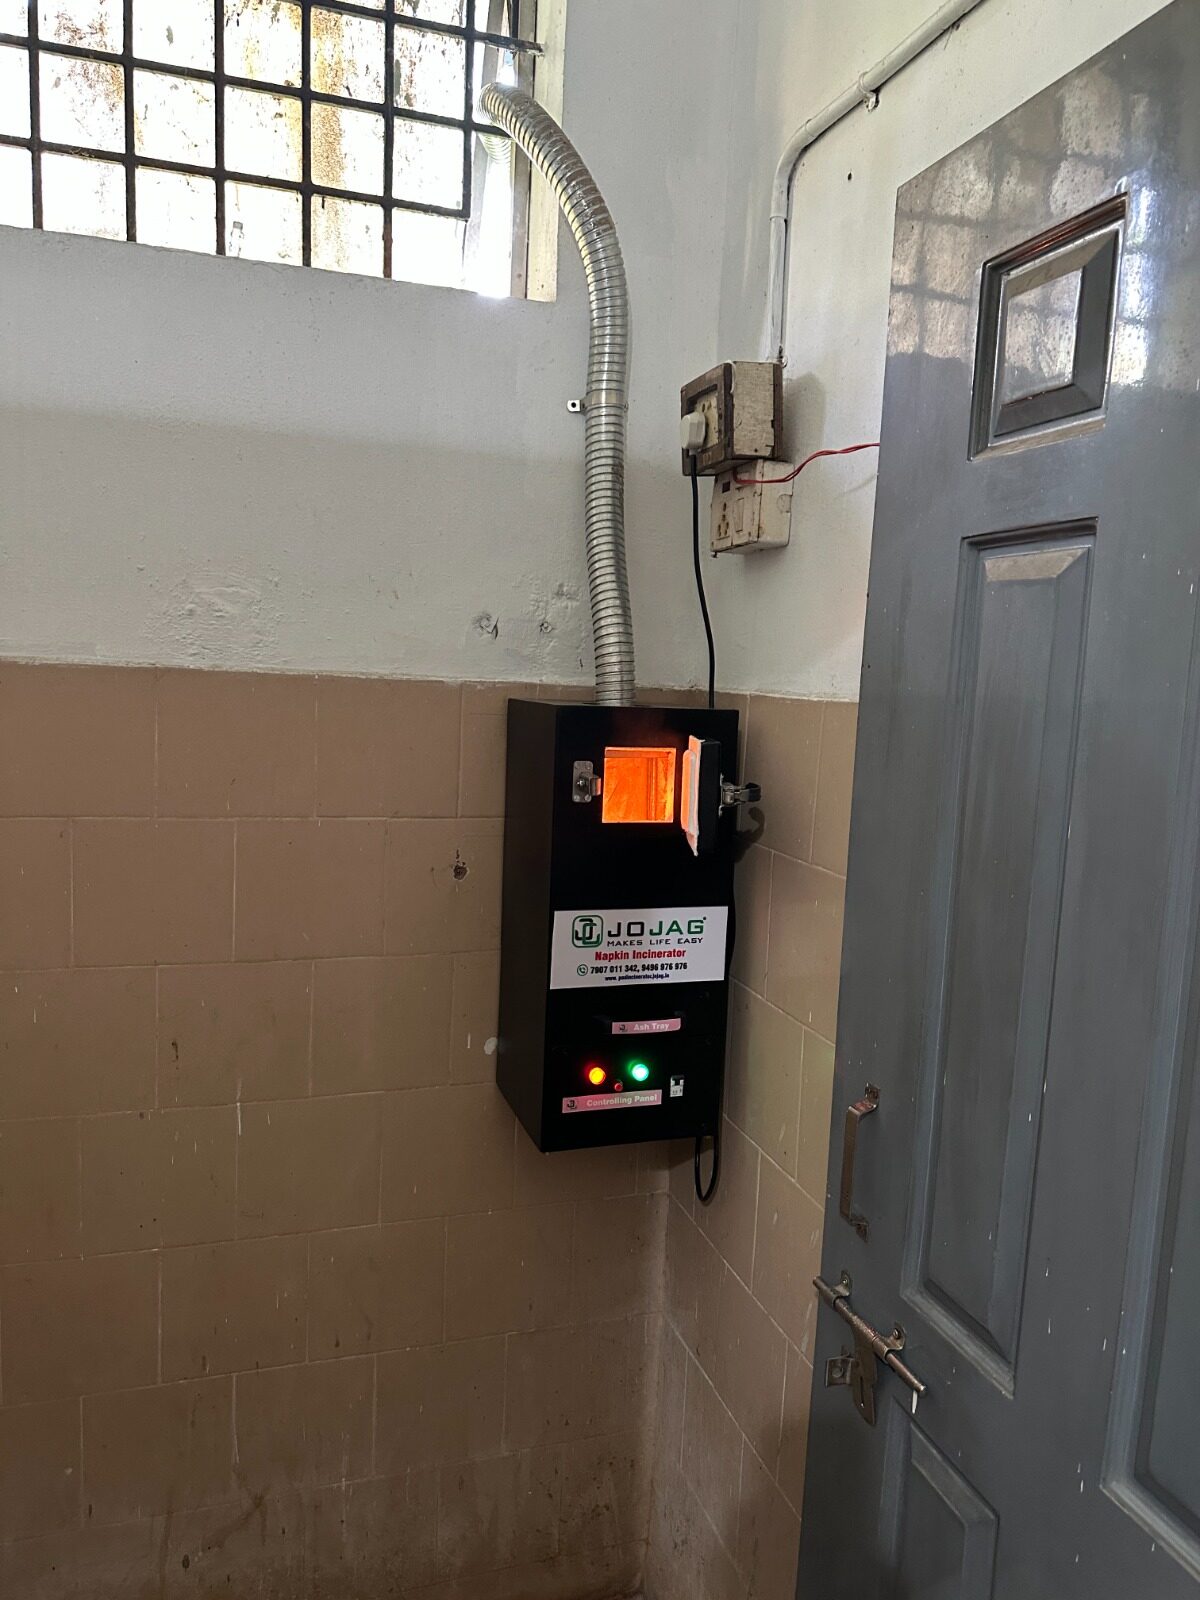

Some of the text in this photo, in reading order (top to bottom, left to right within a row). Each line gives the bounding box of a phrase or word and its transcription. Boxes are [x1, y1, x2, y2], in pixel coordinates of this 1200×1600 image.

[607, 919, 704, 938] JOJAG
[607, 939, 643, 947] MAKES
[677, 937, 703, 945] EASY
[595, 949, 686, 962] Napkin Incinerator
[591, 966, 608, 974] 7907
[609, 965, 622, 973] 011
[660, 963, 673, 971] 976
[675, 962, 688, 970] 976
[633, 1022, 650, 1031] Ash
[651, 1022, 670, 1031] Tray
[586, 1096, 632, 1107] Controlling
[634, 1094, 657, 1102] Panel
